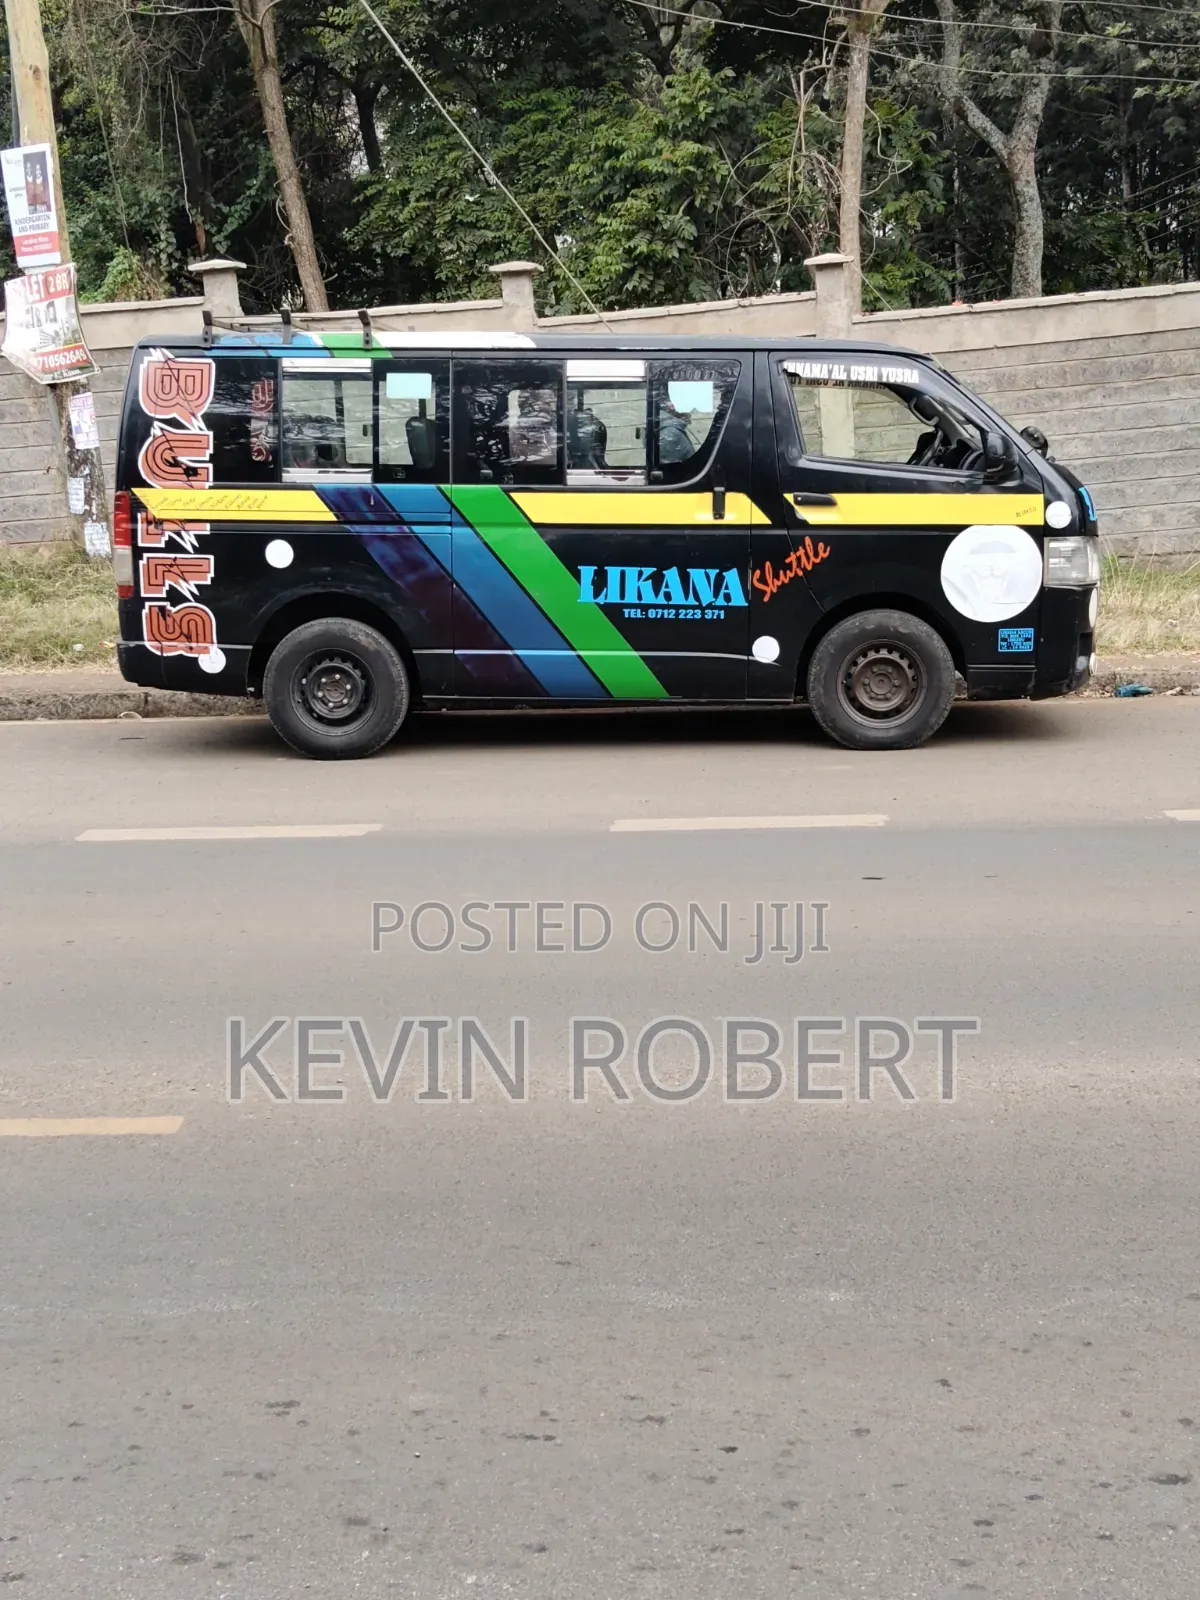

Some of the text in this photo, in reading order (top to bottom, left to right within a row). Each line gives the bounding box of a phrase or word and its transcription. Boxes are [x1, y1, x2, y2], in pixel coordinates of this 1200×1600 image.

[14, 214, 51, 225] KINDERGARTEN
[18, 222, 50, 233] AND PRIMARY
[25, 273, 46, 302] LET
[850, 365, 879, 382] USRI
[881, 366, 919, 383] YUSRA
[752, 536, 831, 603] Shuttle
[577, 565, 748, 607] LIKANA
[623, 608, 725, 619] TEL: 0712 223 371
